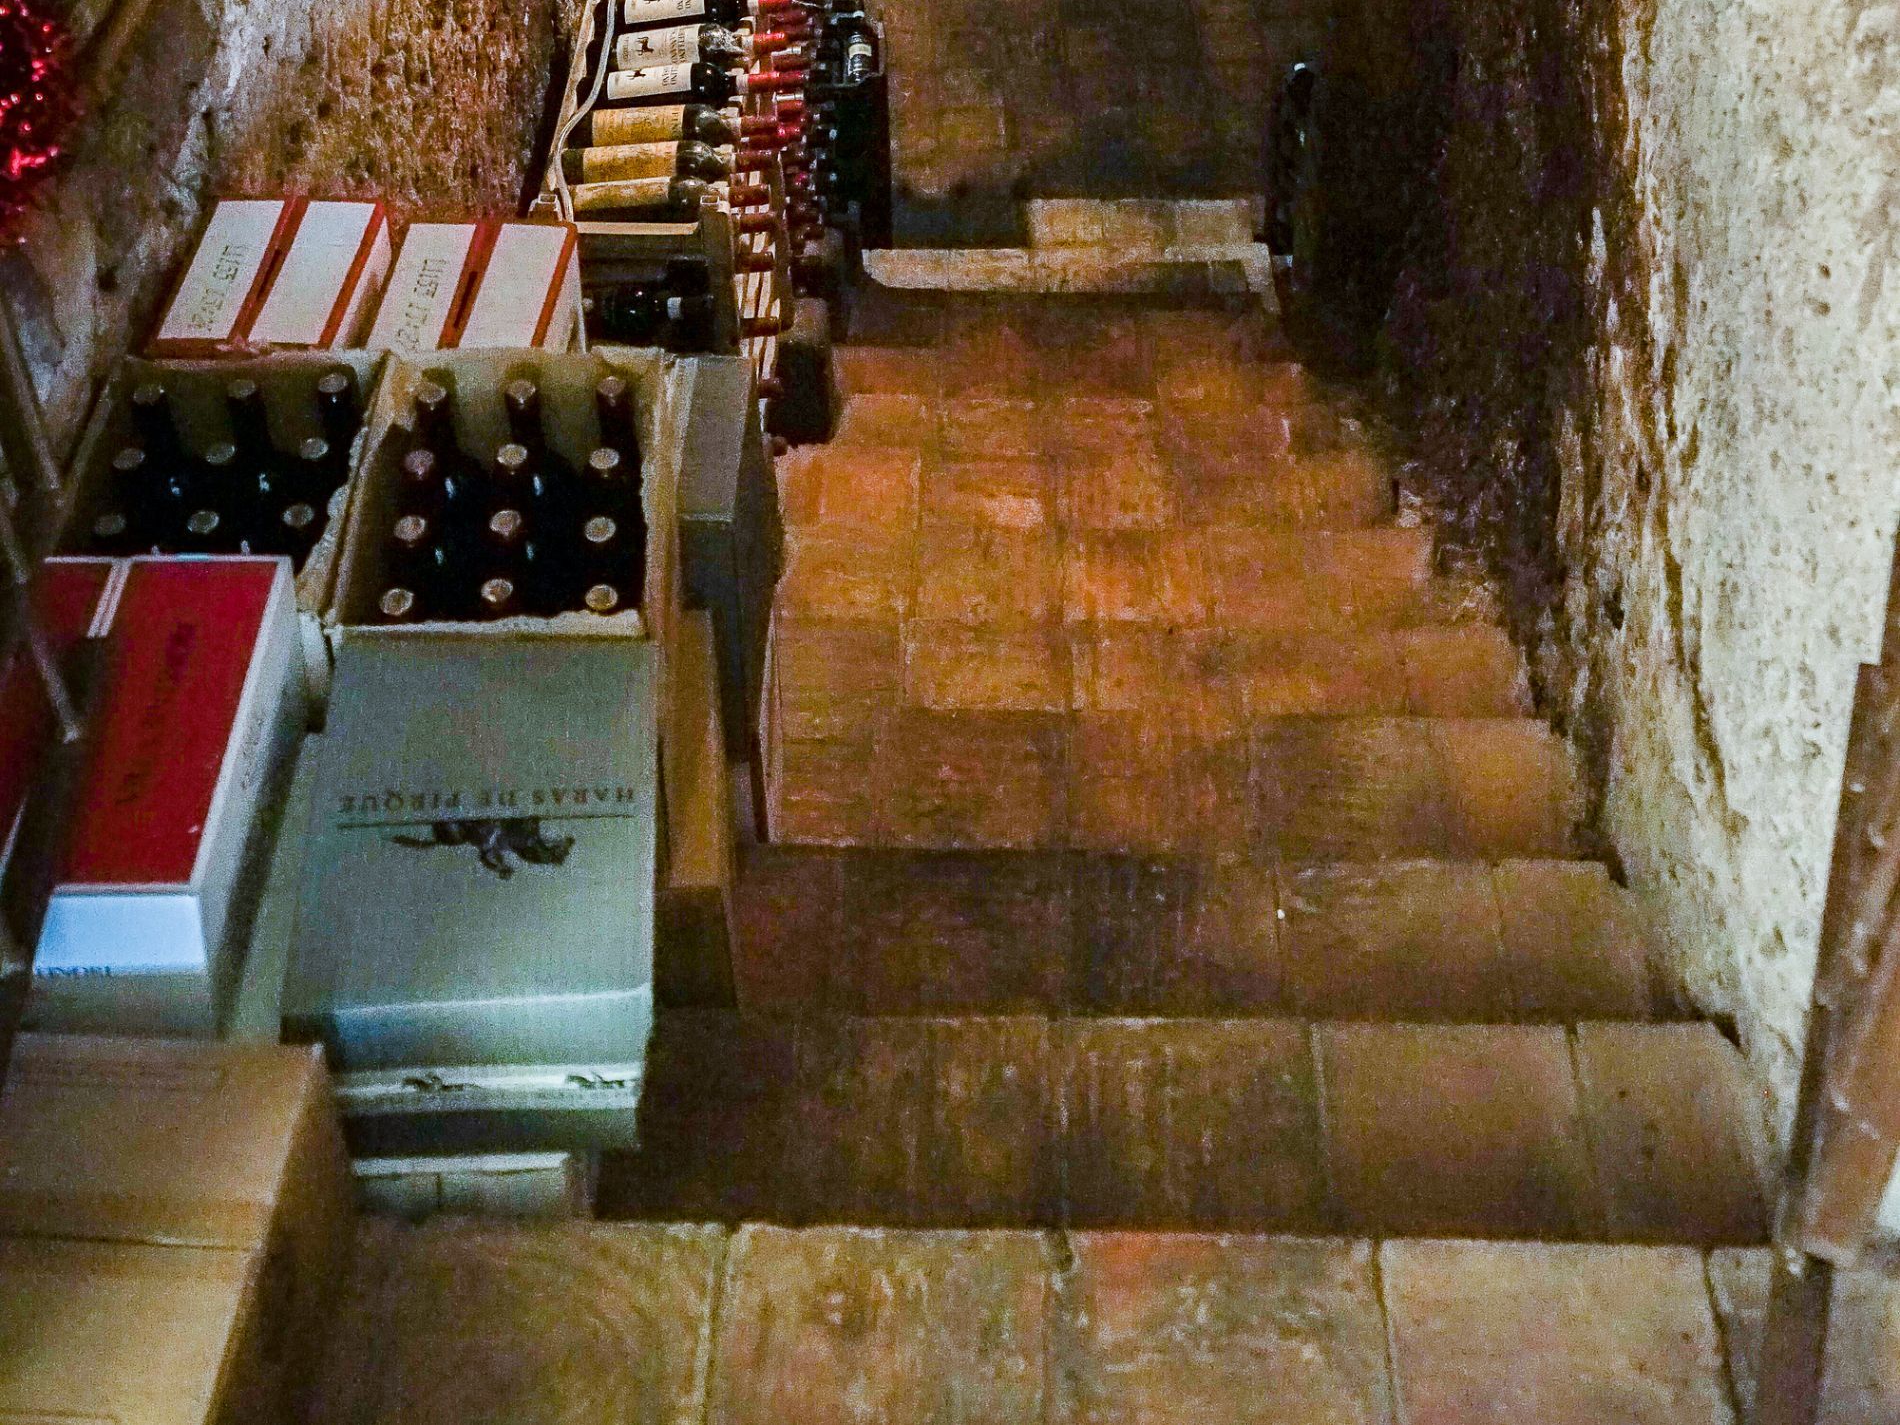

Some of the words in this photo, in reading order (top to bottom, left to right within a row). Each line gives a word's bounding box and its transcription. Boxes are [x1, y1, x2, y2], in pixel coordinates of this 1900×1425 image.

[337, 790, 461, 813] PIRQUE
[478, 789, 518, 808] DE
[532, 787, 634, 806] HARAS
